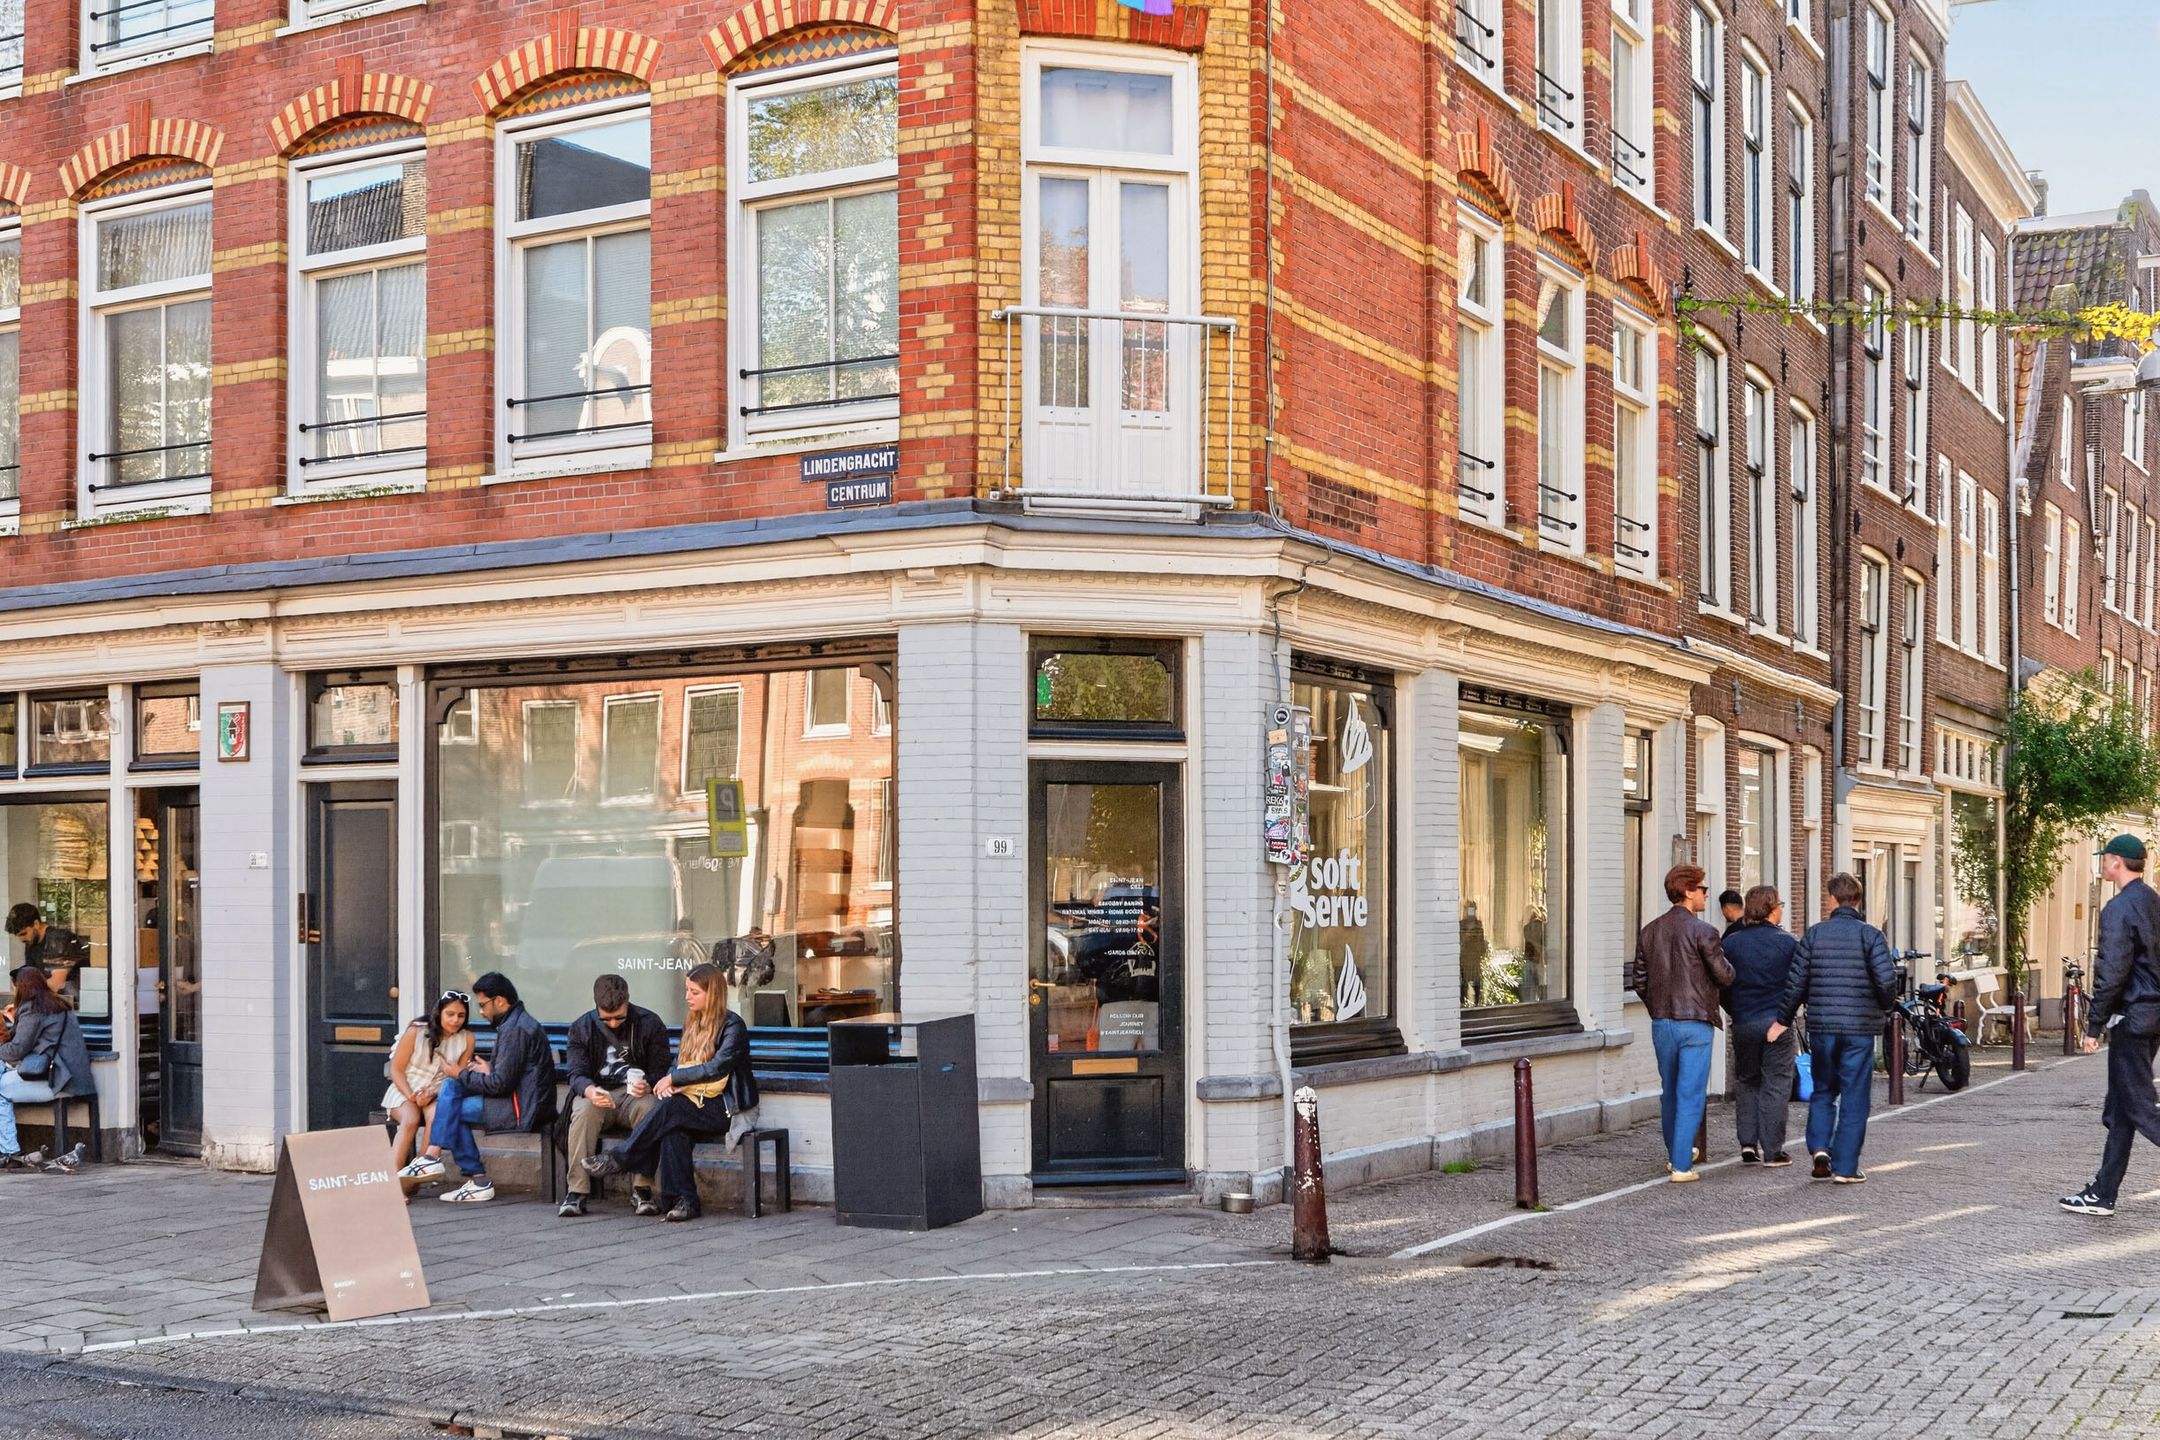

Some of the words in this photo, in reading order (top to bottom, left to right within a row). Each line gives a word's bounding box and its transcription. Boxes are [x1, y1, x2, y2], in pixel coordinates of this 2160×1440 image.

[804, 451, 895, 476] LINDENGRACHT
[831, 482, 886, 502] CENTRUM
[994, 839, 1007, 853] 99
[1311, 847, 1361, 890] soft
[1303, 895, 1368, 929] serve
[617, 958, 693, 970] SAINT-JEAN
[309, 1171, 389, 1191] SAINT-JEAN
